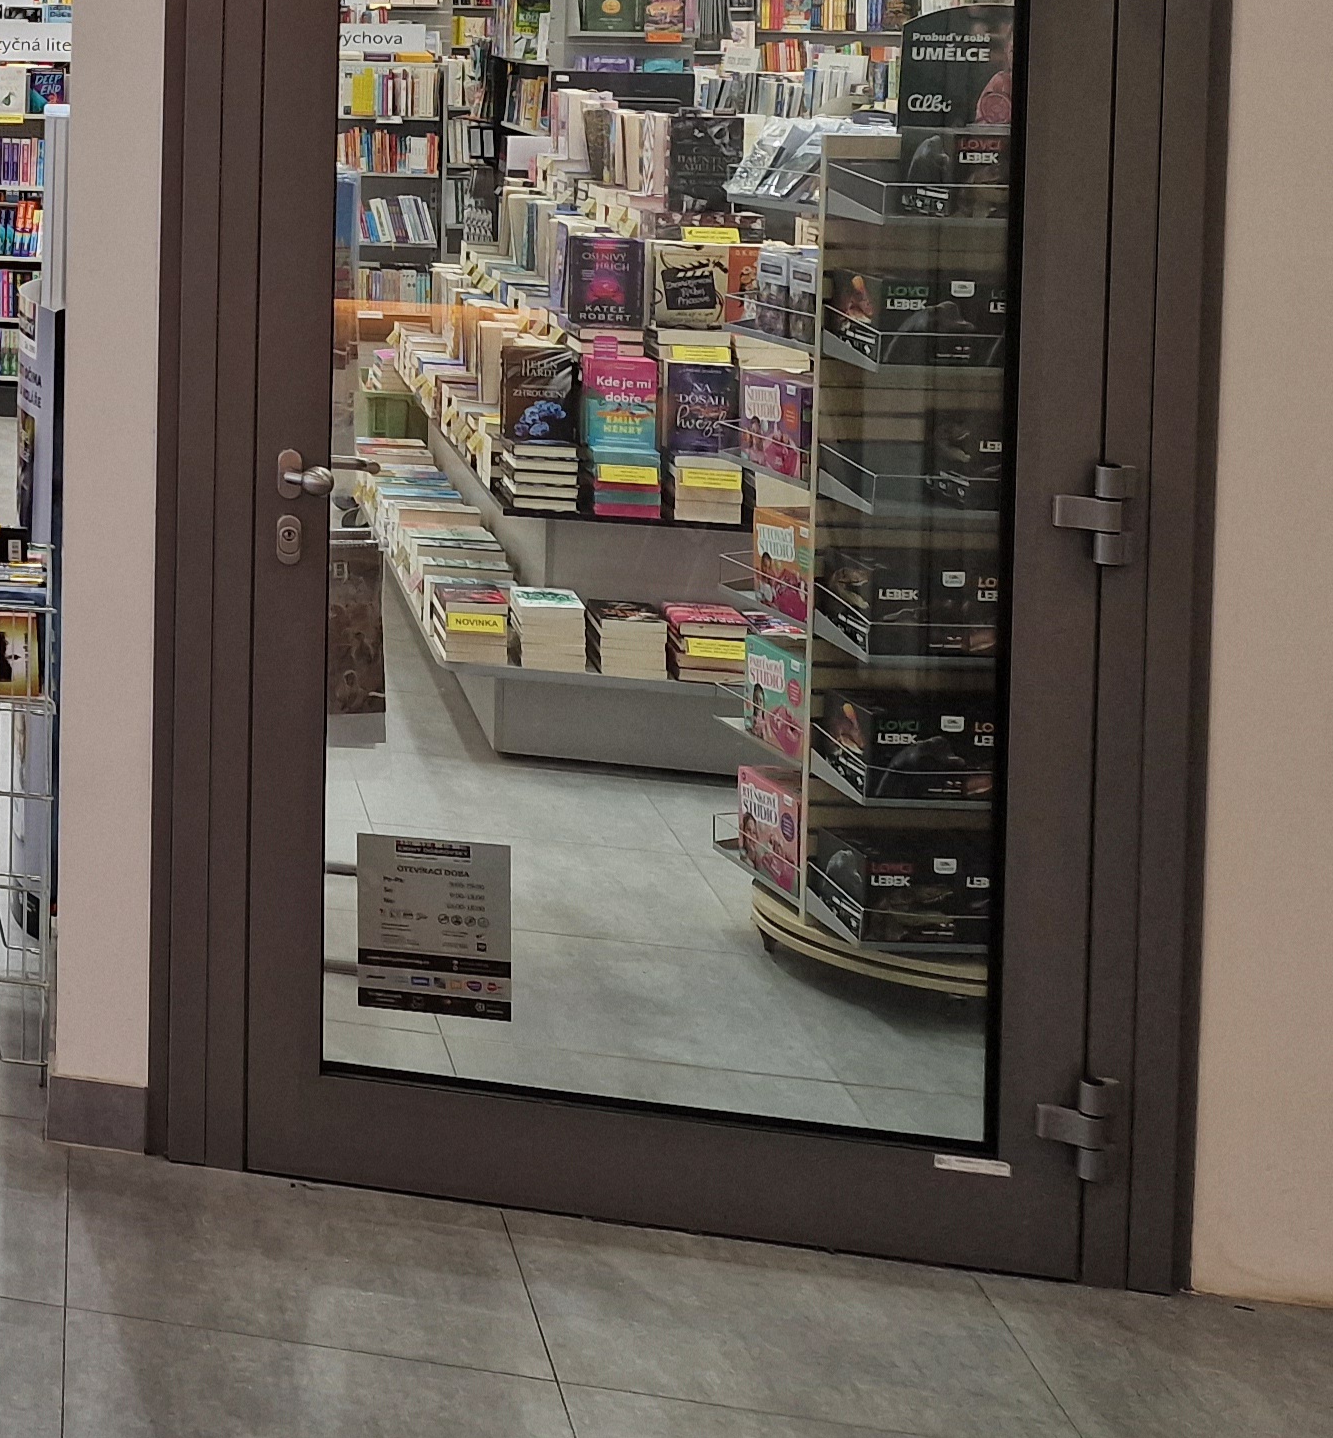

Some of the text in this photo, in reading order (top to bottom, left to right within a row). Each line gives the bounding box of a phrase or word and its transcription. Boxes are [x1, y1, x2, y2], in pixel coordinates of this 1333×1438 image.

[912, 32, 955, 43] Probuď
[964, 33, 991, 43] sobě
[911, 42, 991, 62] UMĚLCE
[34, 74, 63, 86] DEEP
[40, 84, 62, 95] END
[959, 151, 999, 164] LEBEK
[886, 298, 927, 311] LEBEK
[579, 312, 632, 322] ROBERT
[597, 375, 652, 390] Kde je mi
[691, 382, 712, 393] NA
[605, 390, 643, 403] dobře
[745, 402, 781, 420] STUDIO
[603, 424, 644, 435] HENRY
[759, 542, 795, 560] STUDIO
[878, 588, 919, 601] LEBEK
[454, 616, 499, 628] NOVINKA
[750, 669, 784, 688] STUDIO
[877, 732, 917, 745] LEBEK
[743, 798, 778, 825] STUDIO
[444, 869, 471, 878] DOBA
[870, 875, 911, 887] LEBEK
